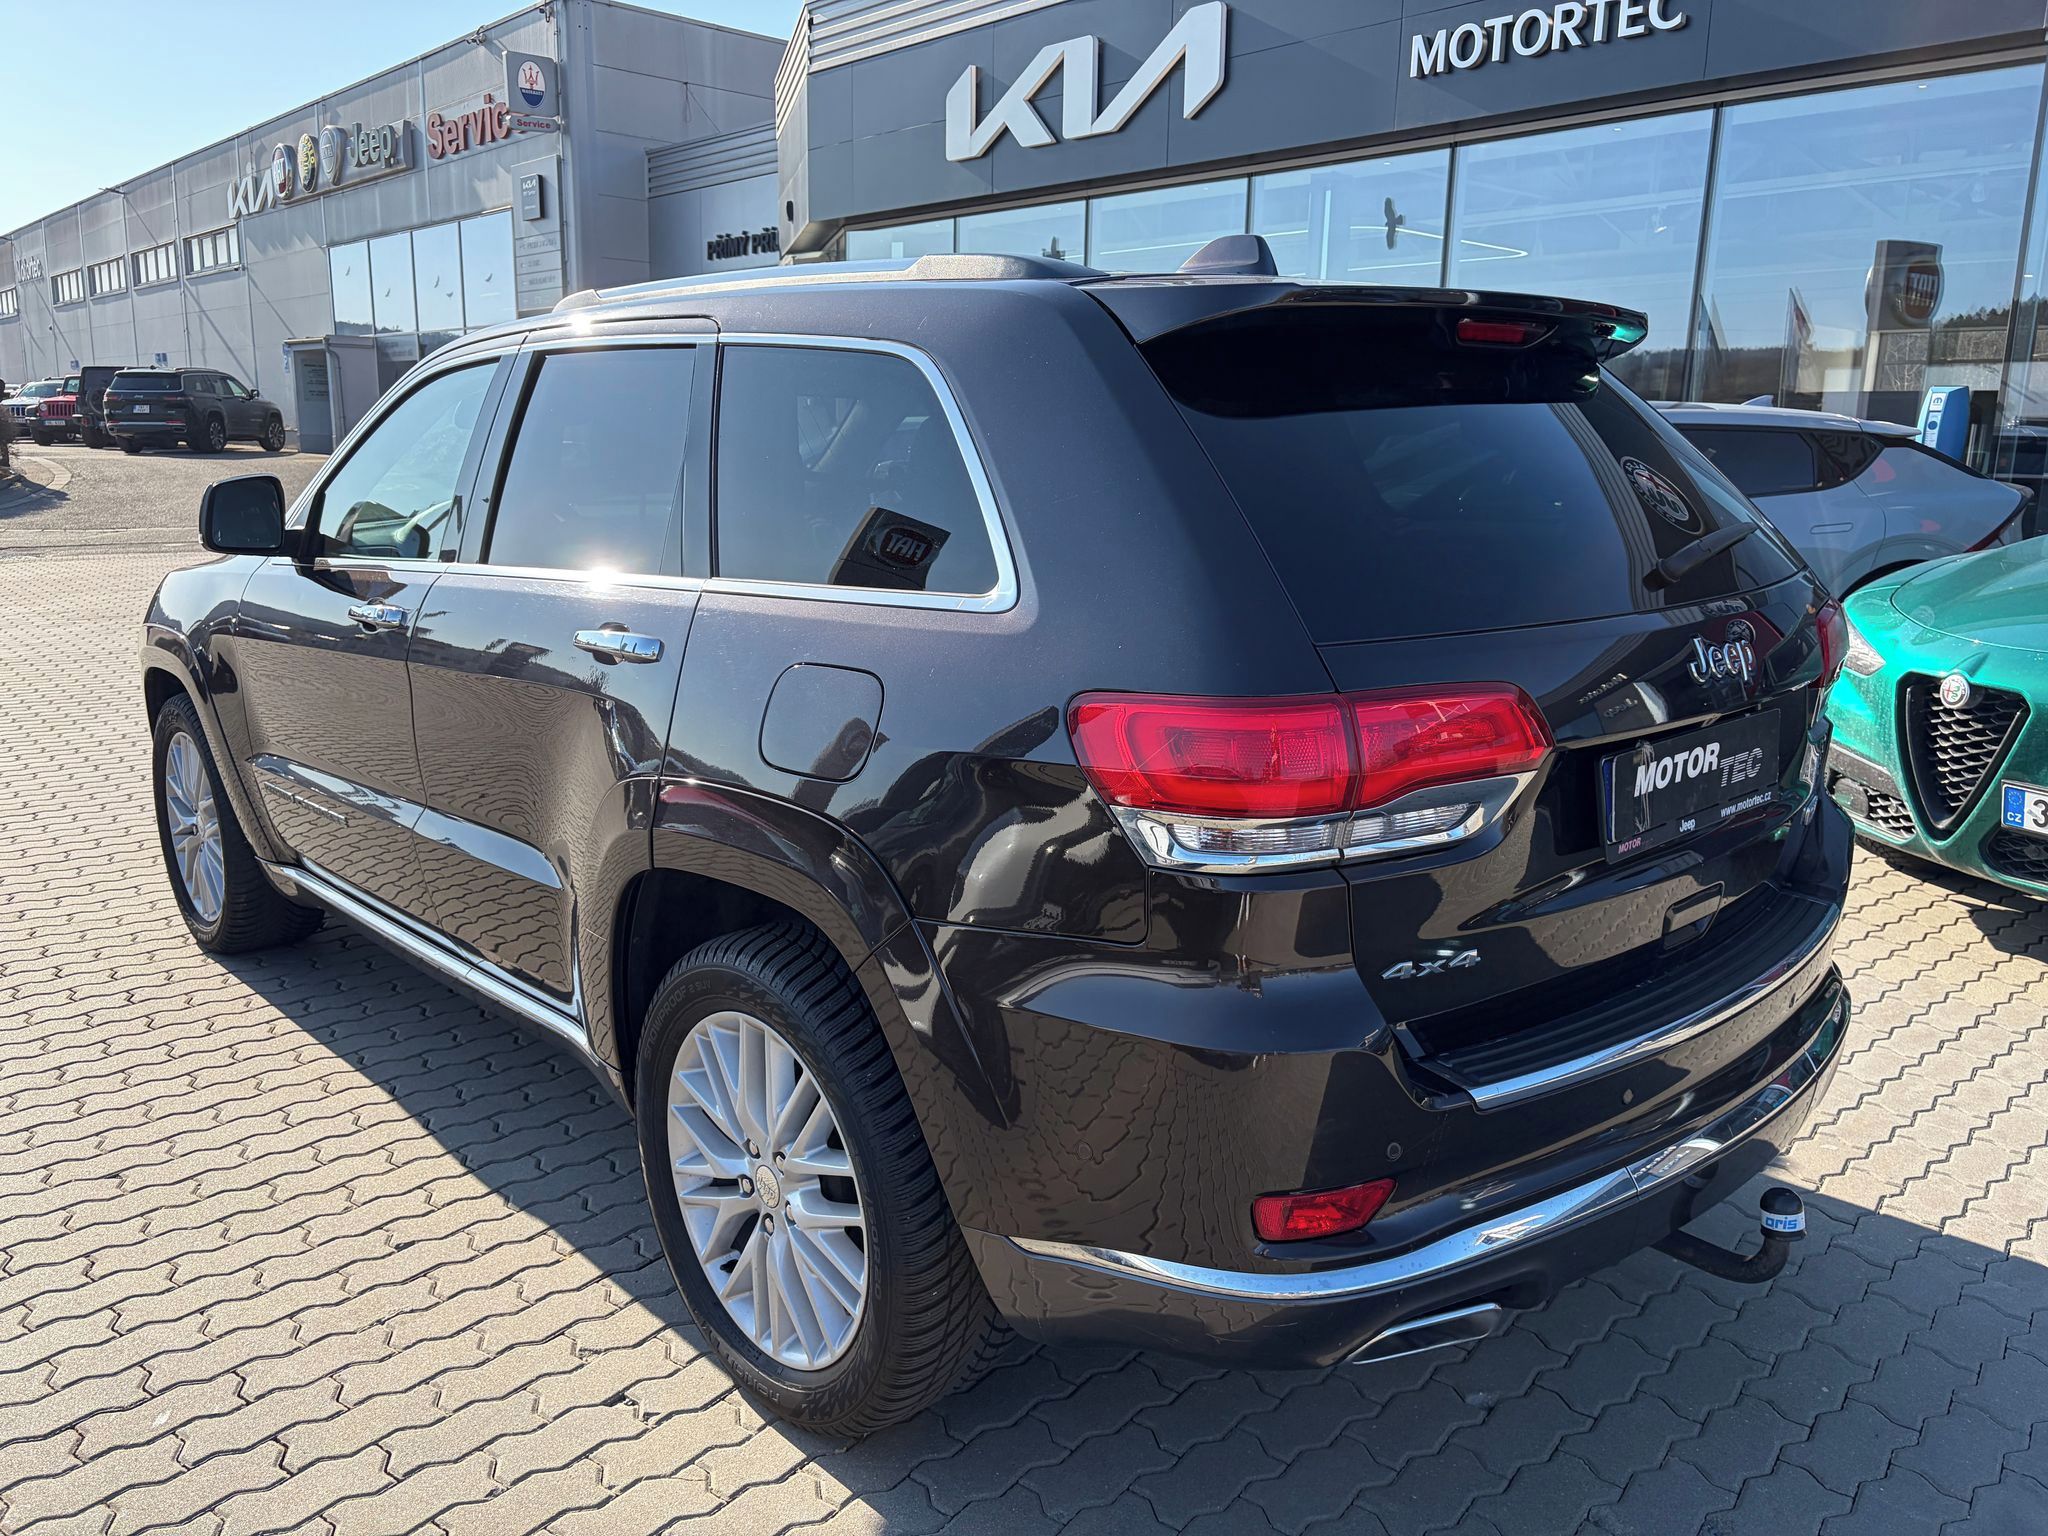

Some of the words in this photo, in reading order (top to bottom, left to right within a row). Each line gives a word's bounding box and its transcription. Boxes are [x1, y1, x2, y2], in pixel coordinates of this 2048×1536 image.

[1410, 0, 1687, 79] MOTORTEC
[945, 1, 1229, 162] KIA
[347, 122, 396, 168] Jeep
[427, 93, 518, 160] Servic
[516, 118, 551, 129] Service
[227, 168, 275, 219] KIA
[1687, 633, 1757, 688] Jeep
[1634, 742, 1720, 797] MOTOR
[1719, 747, 1763, 787] TEC
[1679, 818, 1696, 833] Jeep
[1720, 790, 1772, 817] www.motortec.cz
[2007, 811, 2022, 823] CZ
[1617, 836, 1642, 855] MOTOR
